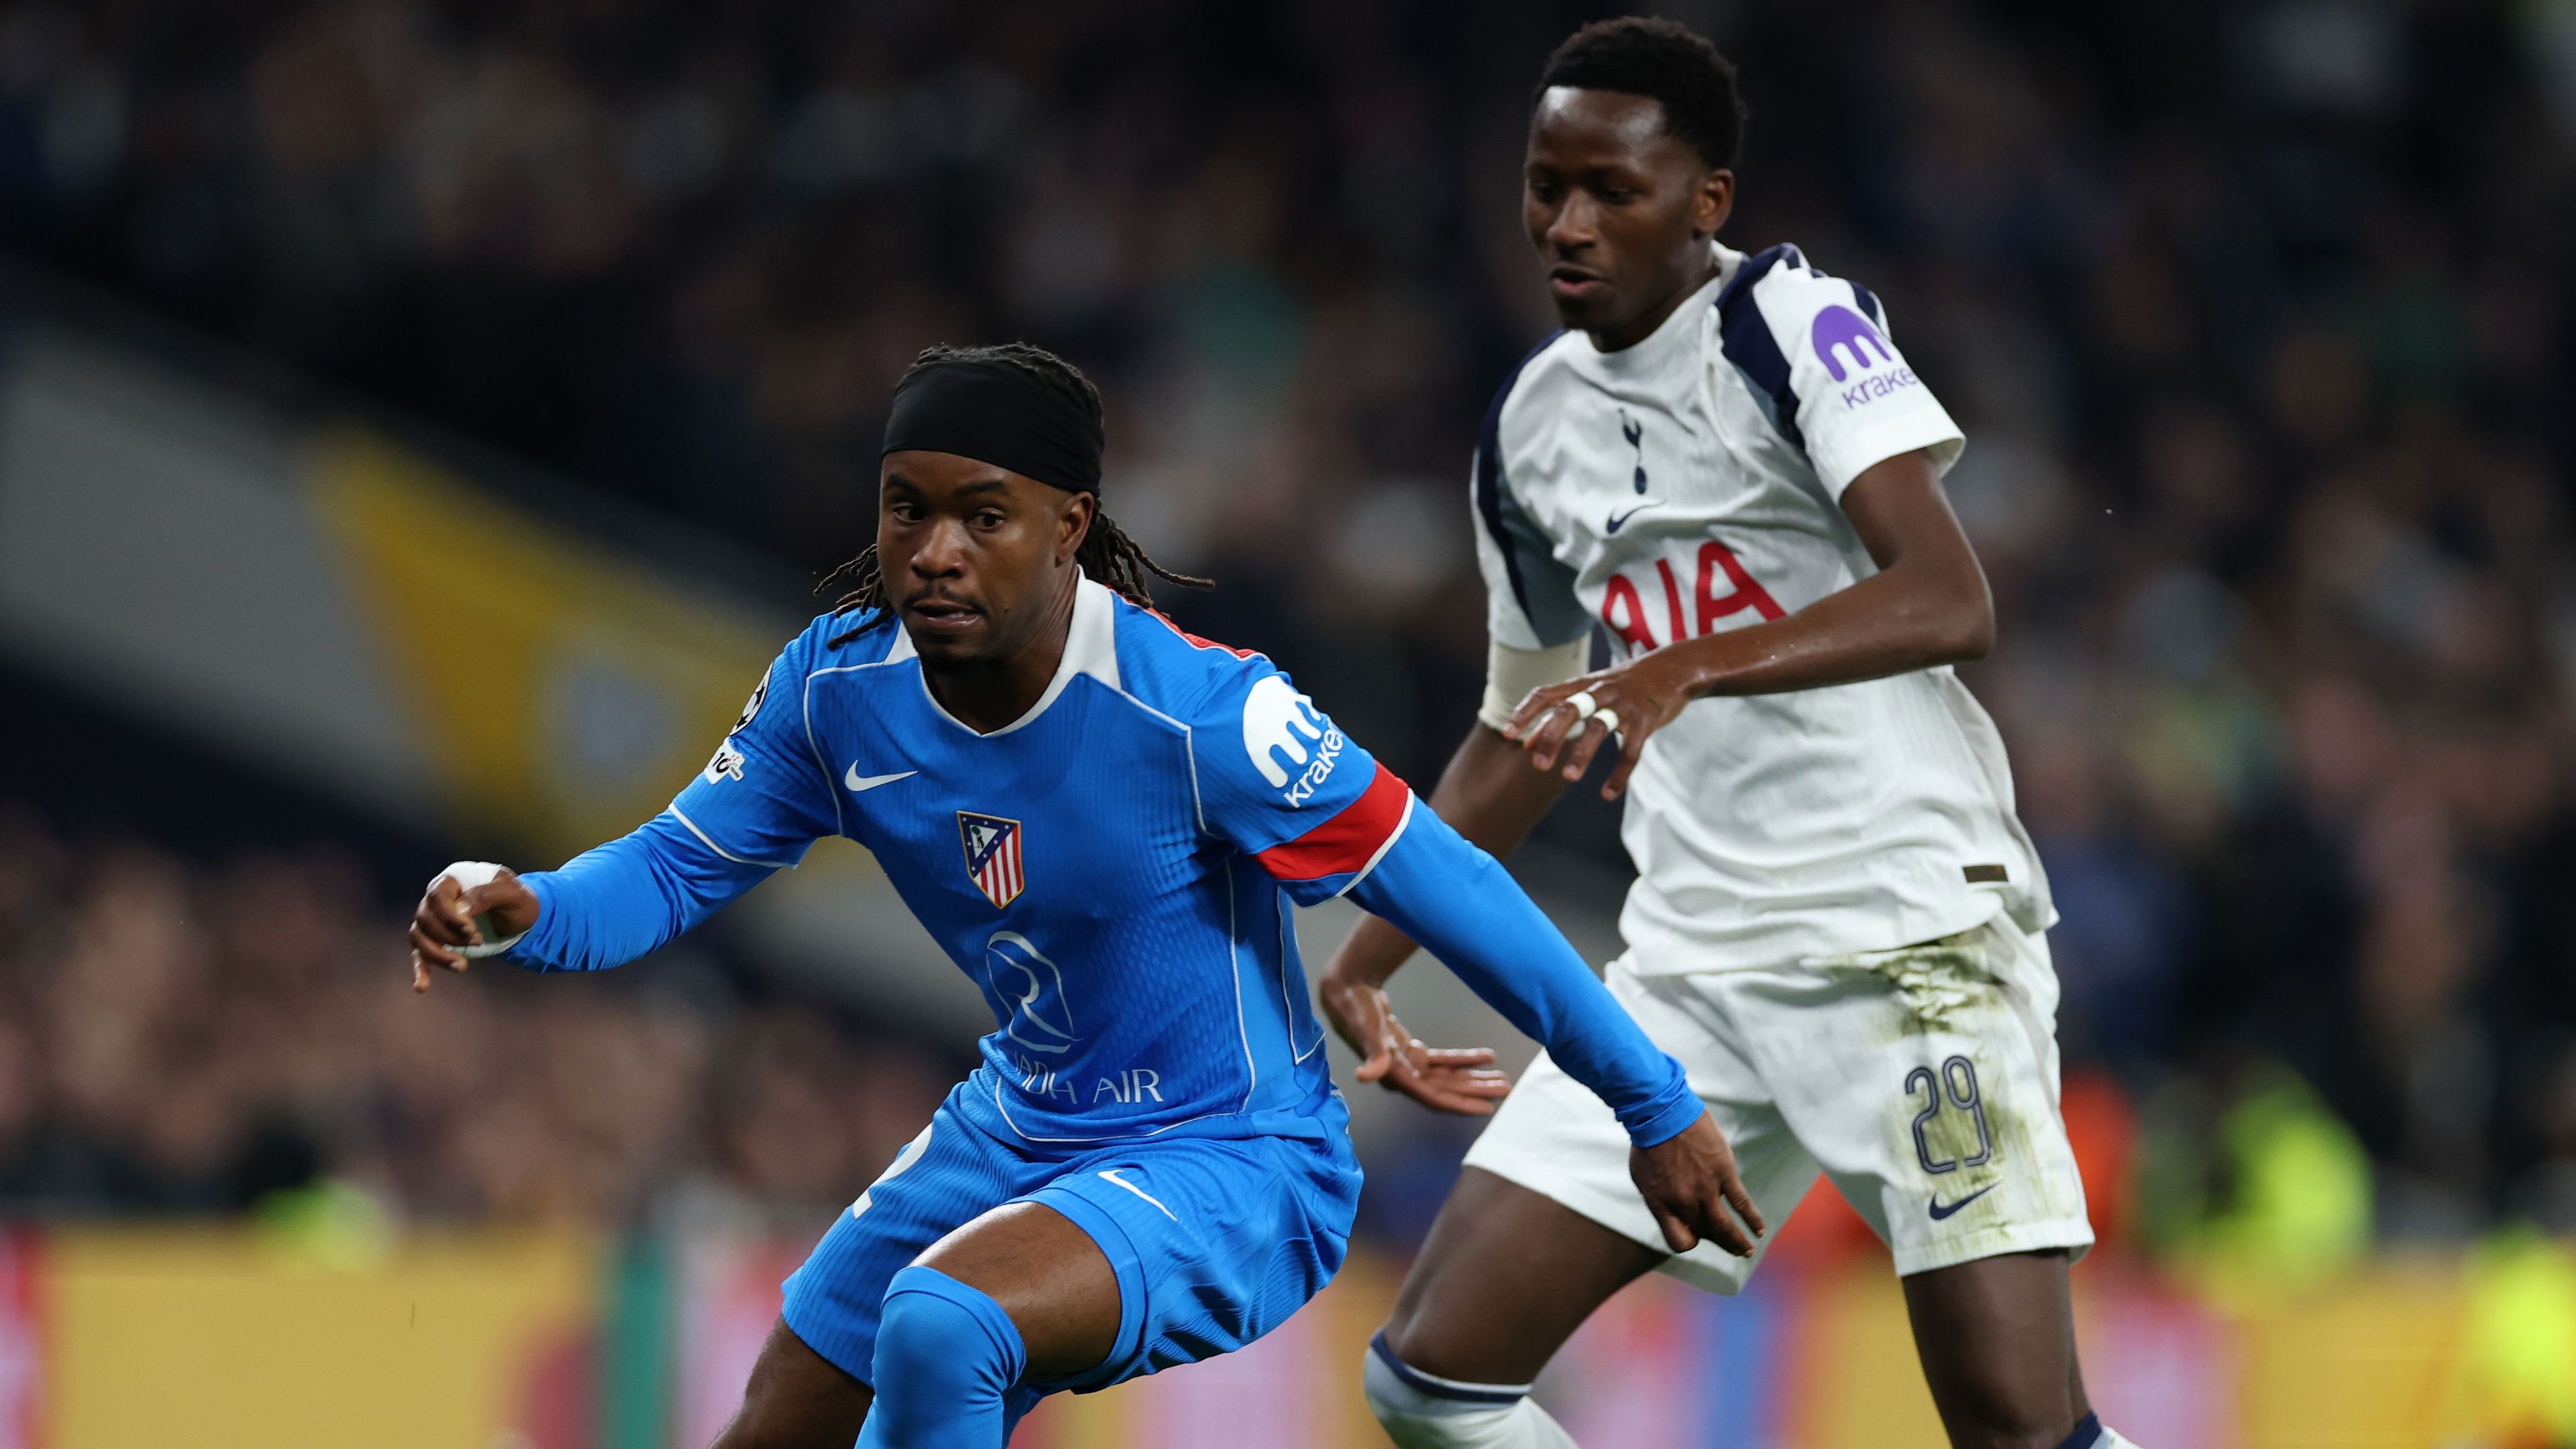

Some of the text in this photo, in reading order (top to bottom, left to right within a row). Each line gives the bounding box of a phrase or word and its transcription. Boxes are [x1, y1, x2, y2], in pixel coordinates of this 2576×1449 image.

[1842, 367, 1917, 410] krake
[1602, 540, 1788, 659] AIA
[1283, 717, 1344, 809] krake
[1093, 1069, 1164, 1103] AIR
[1905, 1055, 1990, 1174] 29
